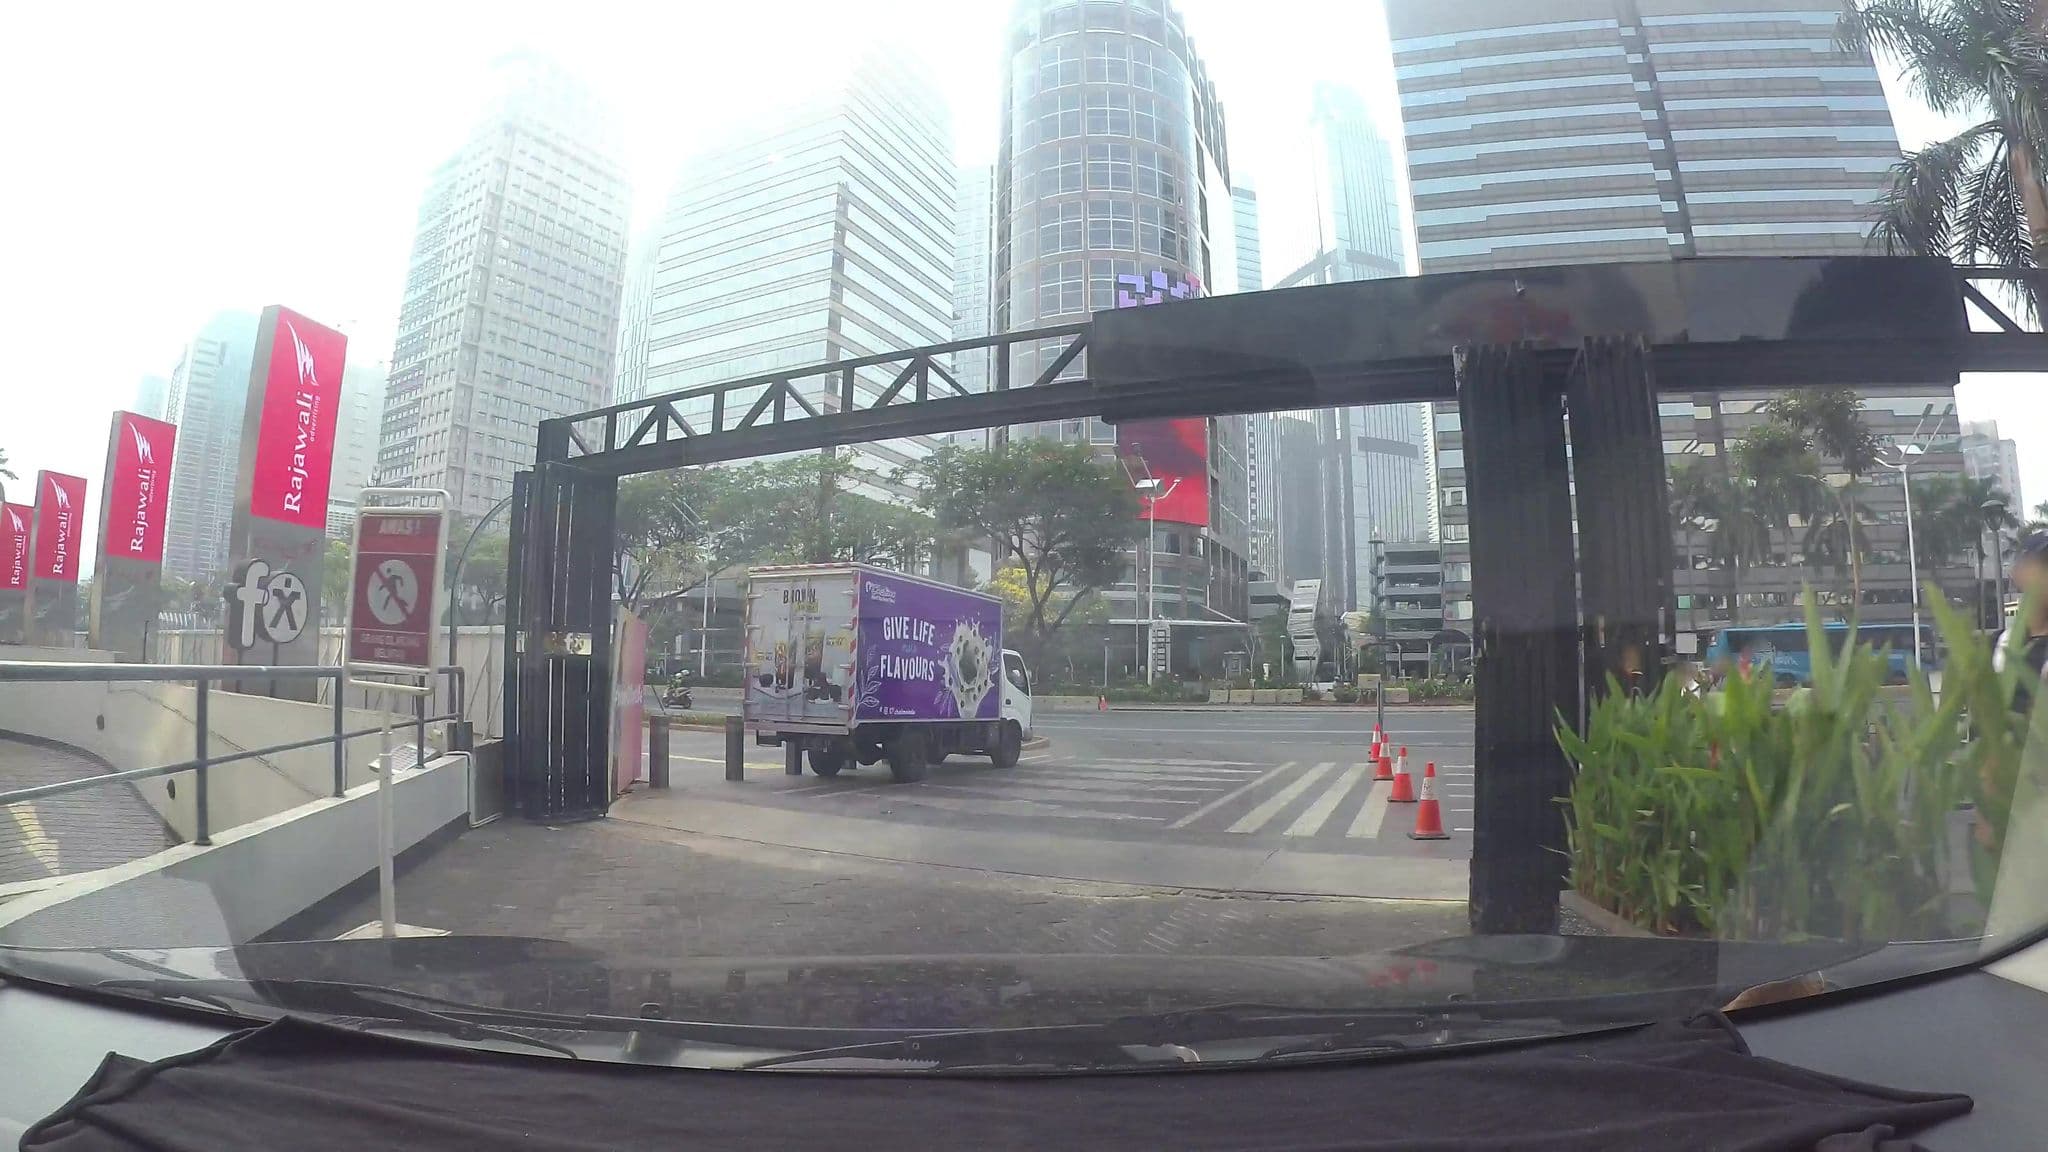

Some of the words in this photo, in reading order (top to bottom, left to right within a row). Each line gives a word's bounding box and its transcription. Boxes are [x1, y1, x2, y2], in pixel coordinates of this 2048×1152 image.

[309, 395, 321, 442] advertising
[283, 391, 314, 514] Rajawali
[130, 468, 151, 553] Rajawali
[11, 534, 23, 585] Rajawali
[53, 511, 69, 574] Rajawali
[883, 616, 910, 641] GIVE
[913, 618, 936, 646] LIFE
[880, 654, 935, 682] FLAVOURS
